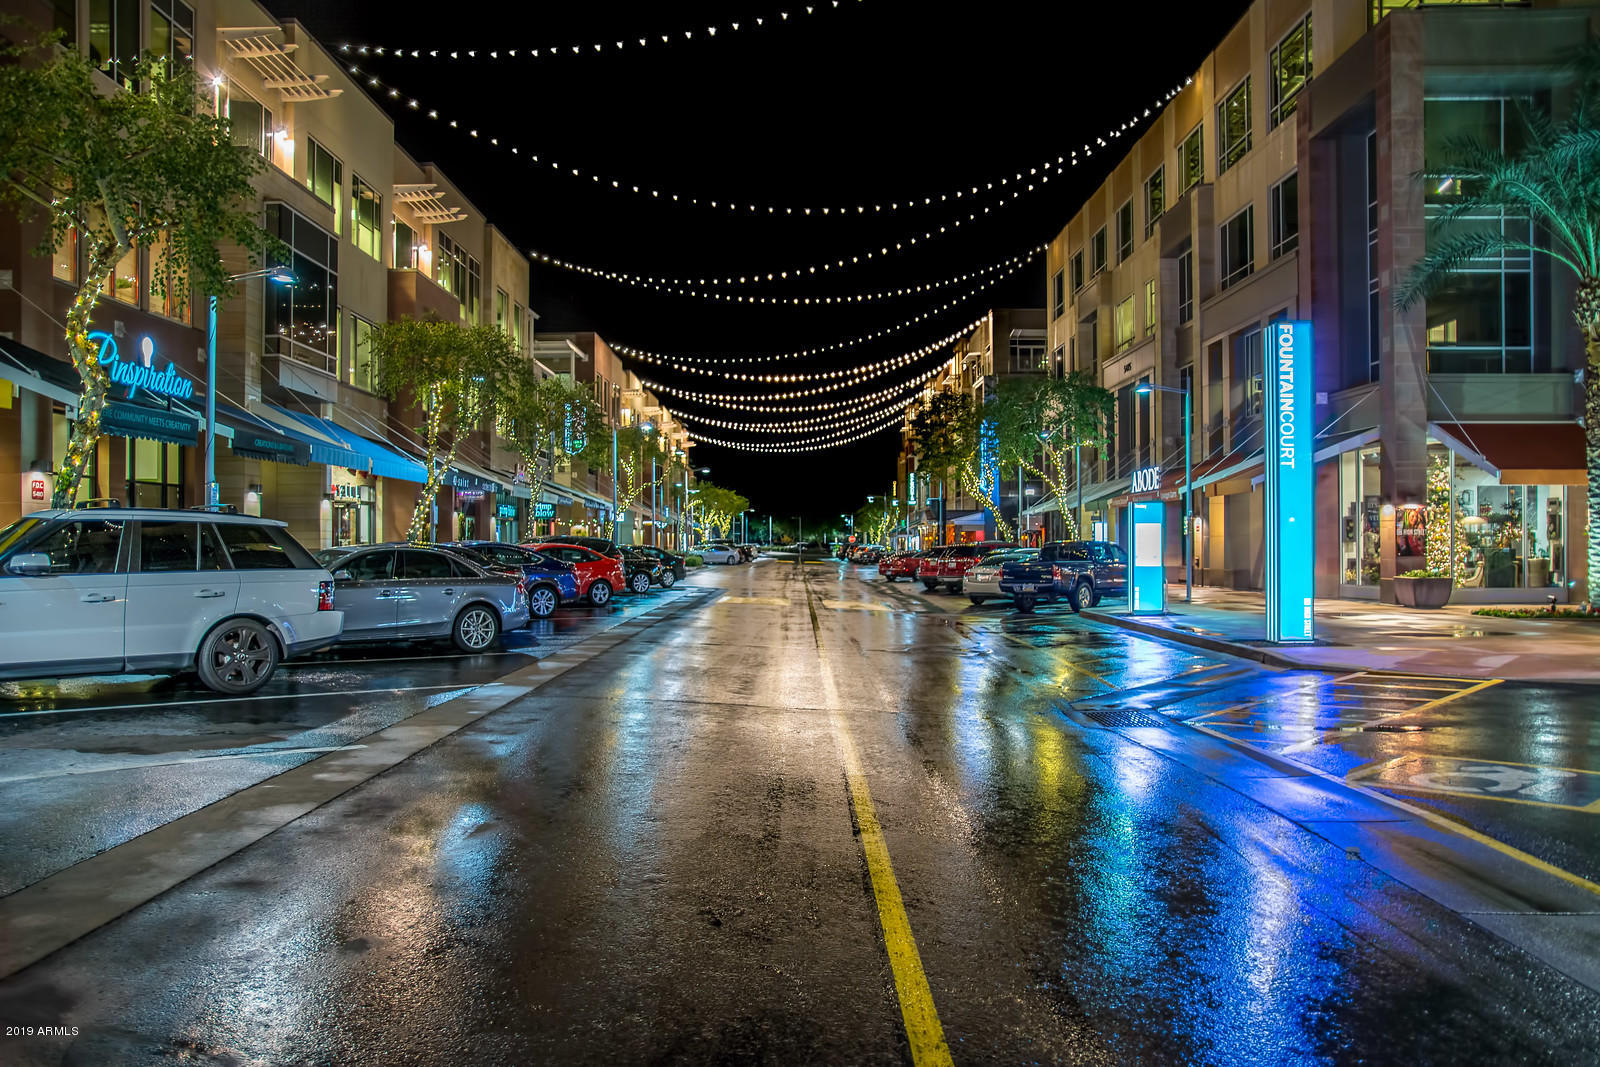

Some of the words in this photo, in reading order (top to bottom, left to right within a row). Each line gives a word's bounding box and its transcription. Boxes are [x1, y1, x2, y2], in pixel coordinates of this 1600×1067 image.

[87, 331, 193, 400] Pinspiration
[114, 409, 149, 425] COMMUNITY
[148, 416, 165, 428] MEETS
[165, 419, 192, 433] CREATIVITY
[1131, 466, 1159, 493] ABODE
[535, 508, 555, 517] blow
